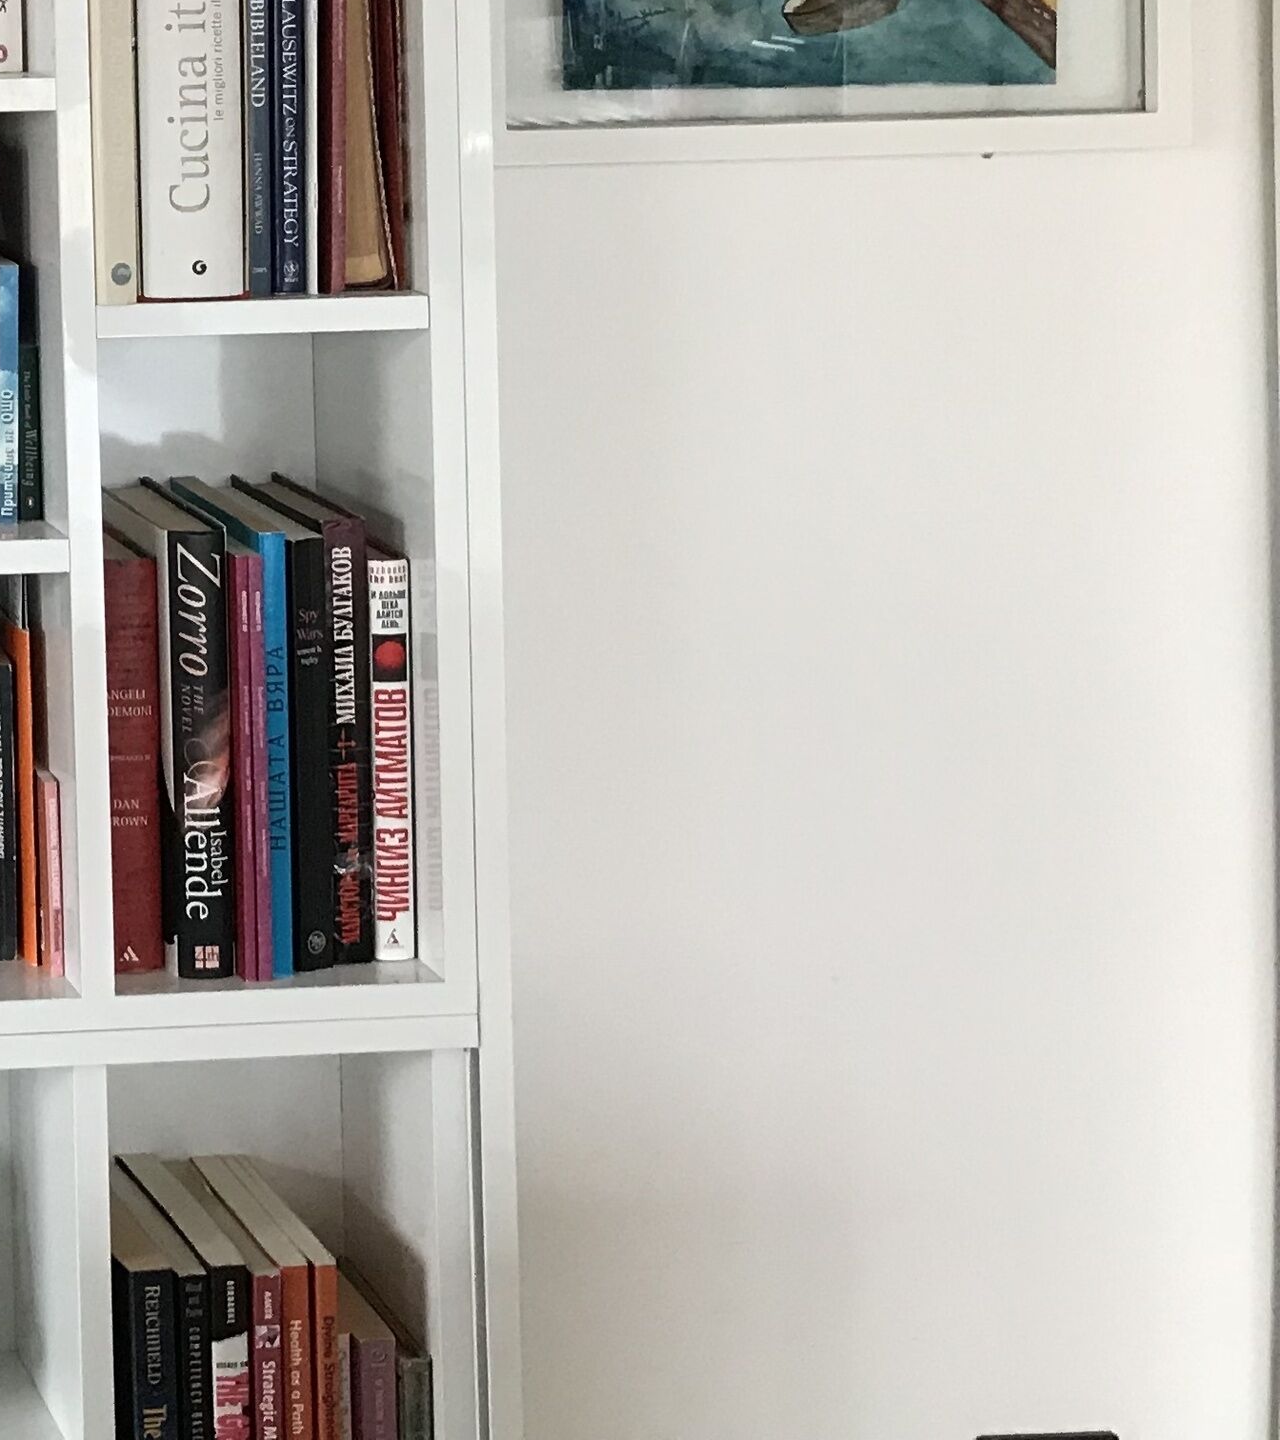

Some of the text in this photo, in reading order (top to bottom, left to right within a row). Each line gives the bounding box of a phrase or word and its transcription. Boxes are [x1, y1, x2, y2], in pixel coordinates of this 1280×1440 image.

[168, 49, 210, 215] Cucina
[285, 117, 296, 139] ON
[282, 139, 300, 248] STRATEGY
[1, 389, 13, 422] ОШО
[175, 540, 222, 678] Zorro
[330, 546, 356, 726] МИХАИЛ БУЛГАКОВ
[183, 771, 224, 922] Allende
[373, 687, 411, 923] ЧИНГИЗ АЙТМАТОВ
[208, 830, 229, 897] Isabel
[144, 1285, 162, 1386] REICHHELD
[260, 1360, 276, 1420] Strategic
